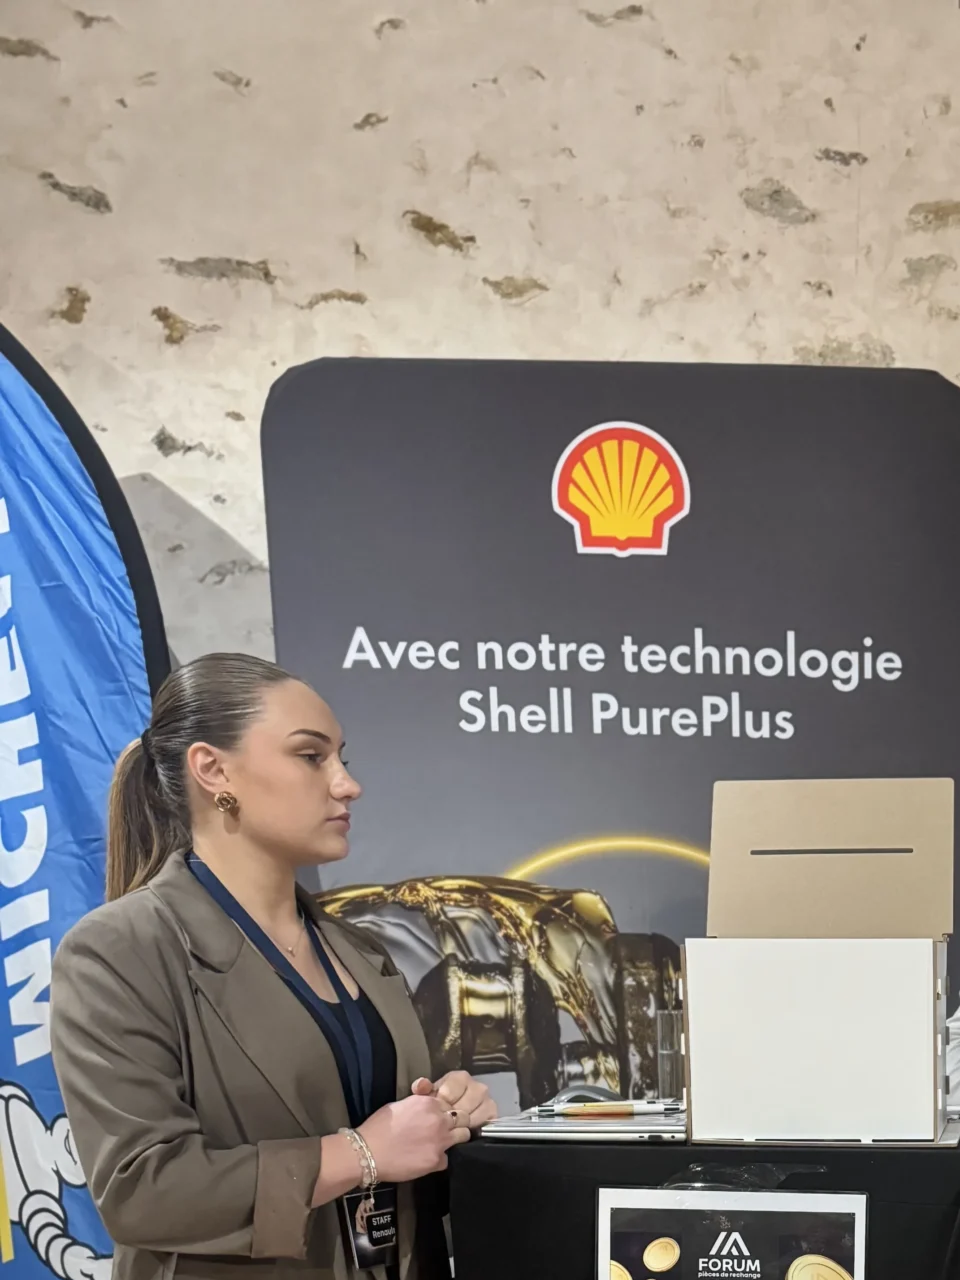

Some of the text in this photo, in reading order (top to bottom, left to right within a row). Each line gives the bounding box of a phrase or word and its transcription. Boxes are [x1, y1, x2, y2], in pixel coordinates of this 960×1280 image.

[342, 626, 903, 692] Avec notre technologie
[458, 686, 795, 740] Shell PurePlus
[372, 1215, 392, 1226] STAFF
[699, 1258, 761, 1272] FORUM
